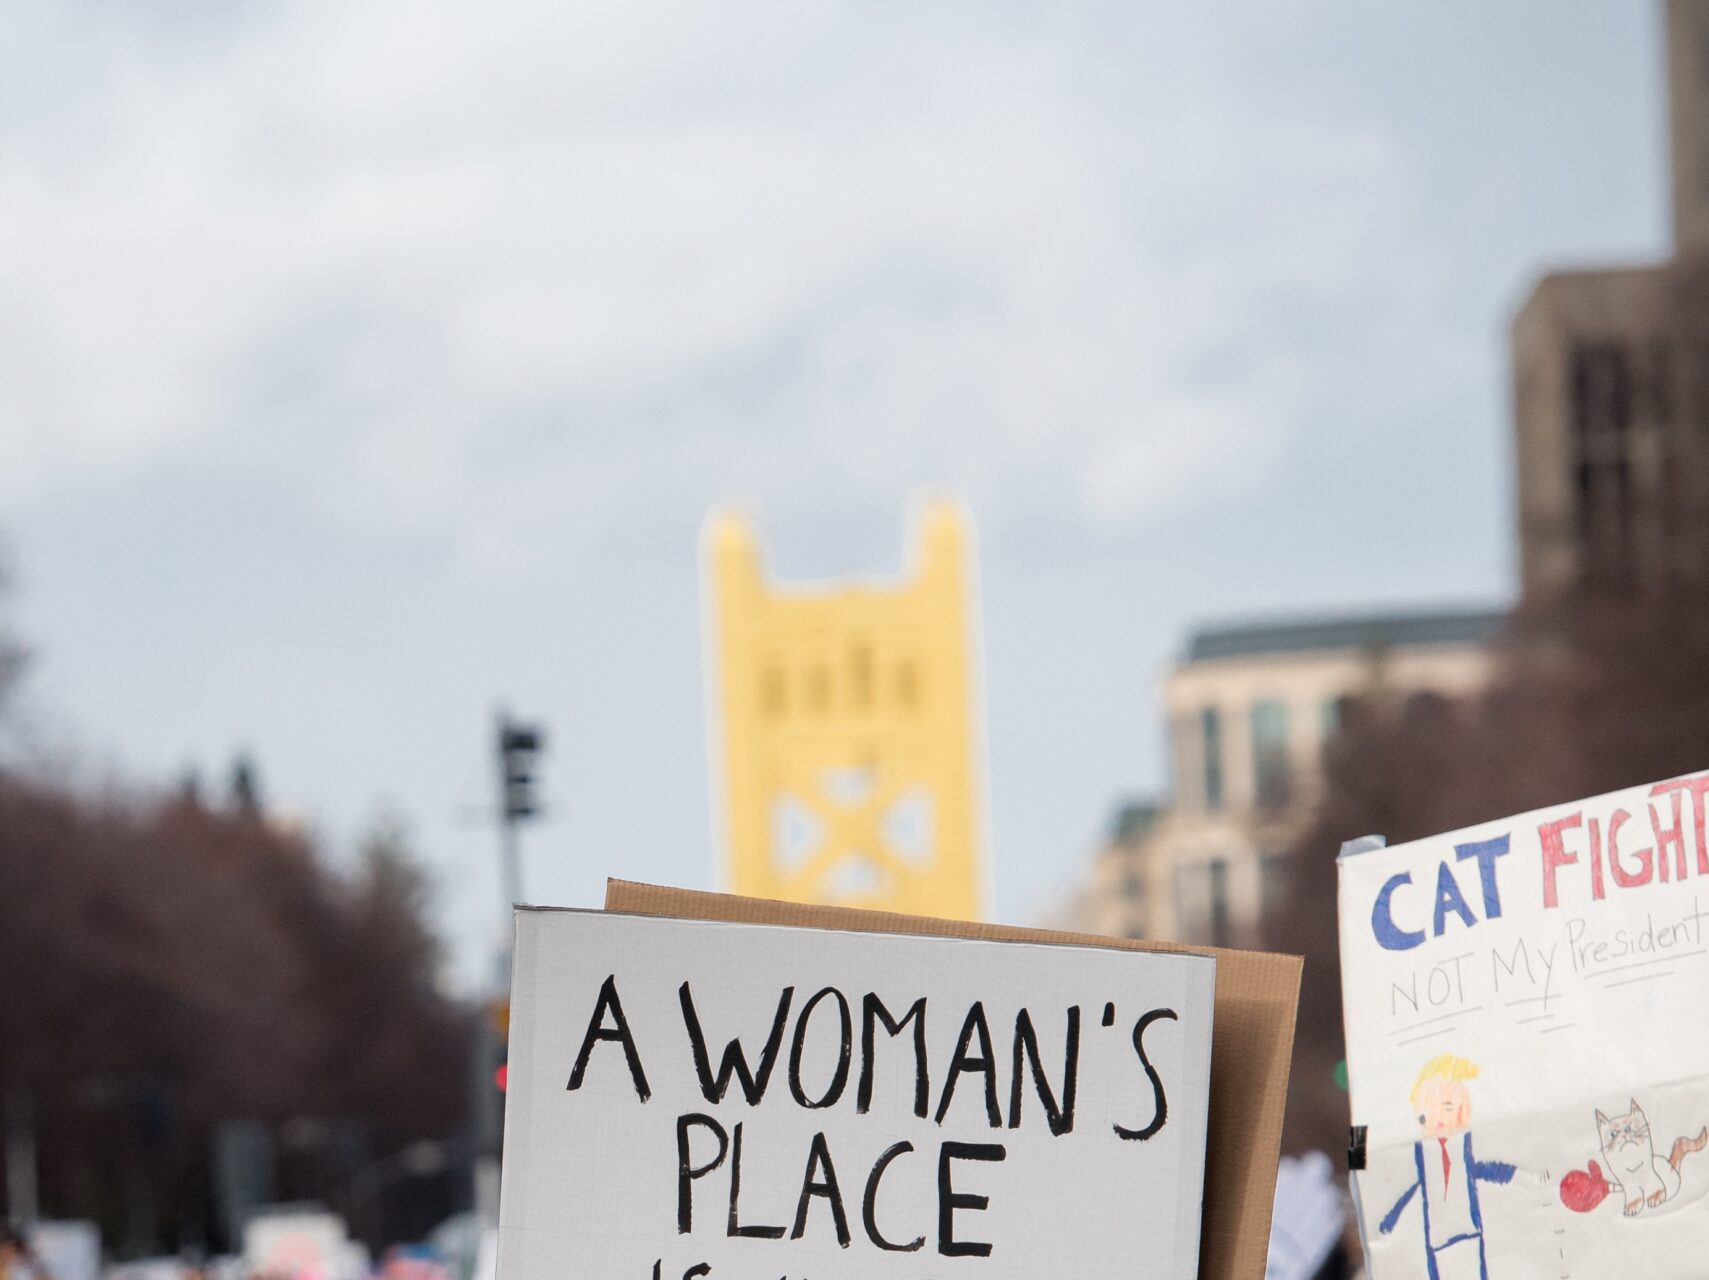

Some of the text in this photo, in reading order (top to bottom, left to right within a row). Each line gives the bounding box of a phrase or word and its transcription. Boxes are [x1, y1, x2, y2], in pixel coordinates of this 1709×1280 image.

[1371, 833, 1511, 950] CAT
[1391, 953, 1476, 1017] NOT
[1564, 894, 1709, 974] President
[566, 973, 1178, 1142] A WOMAN'S
[676, 1112, 1007, 1258] PLACE
